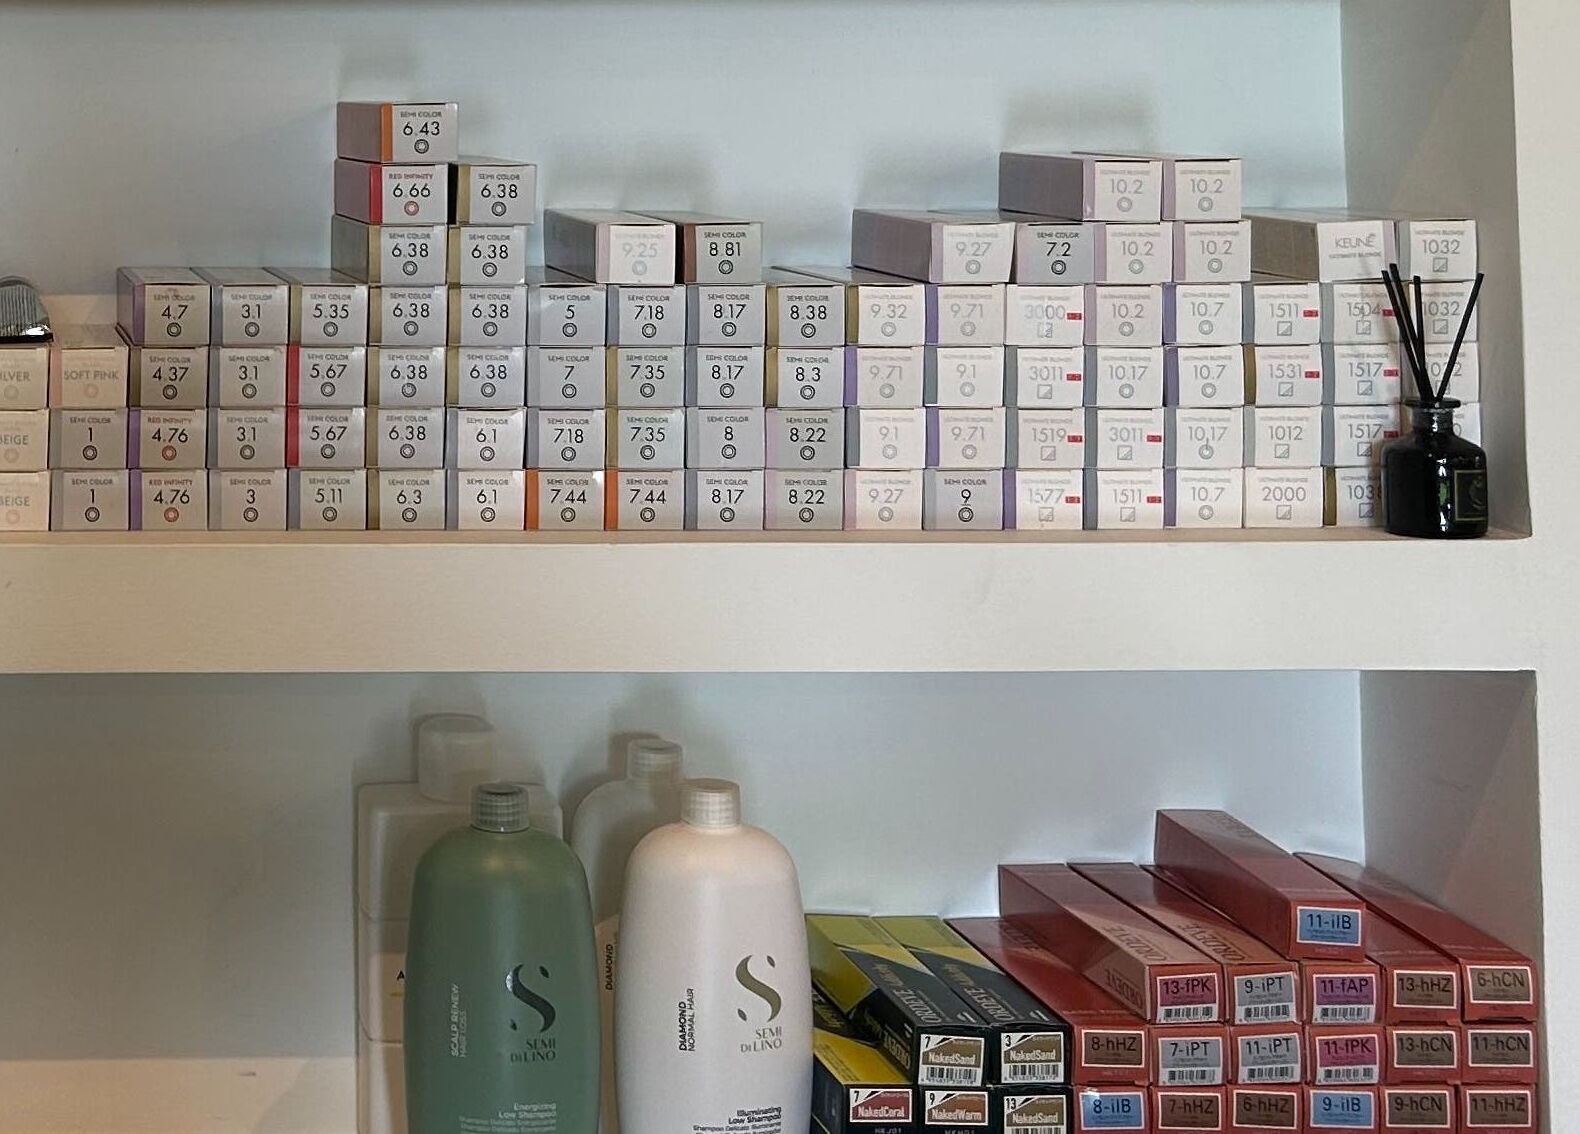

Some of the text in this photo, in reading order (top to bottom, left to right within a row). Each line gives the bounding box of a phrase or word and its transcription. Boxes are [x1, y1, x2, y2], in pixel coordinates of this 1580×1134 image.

[403, 122, 440, 136] 6.43
[1109, 180, 1143, 195] 10.2
[709, 242, 742, 258] 8.81
[1422, 239, 1460, 255] 1032
[313, 304, 349, 319] 5.35
[64, 370, 119, 381] SOFT PINK
[1108, 365, 1149, 381] 10.17
[152, 427, 188, 442] 4.76
[1032, 427, 1067, 443] 1519
[1269, 425, 1303, 441] 1012
[550, 489, 587, 505] 7.44
[1262, 486, 1306, 502] 2000
[1162, 979, 1211, 995] 13-fPK
[1476, 973, 1525, 989] 6-hCN
[679, 1001, 687, 1051] DIAMOND
[756, 1026, 782, 1040] SEMI
[526, 1038, 555, 1050] SEMI
[1005, 1035, 1012, 1047] 3
[1091, 1036, 1137, 1052] 8-hHZ
[1324, 1038, 1372, 1055] 11-fPK
[929, 1052, 975, 1065] NakedSand
[1010, 1049, 1056, 1061] NakedSand
[854, 1090, 859, 1103] 7
[1006, 1098, 1017, 1110] 13
[1395, 1096, 1443, 1112] 9-hCN
[729, 1117, 745, 1125] Low
[932, 1108, 982, 1121] NakedWarm
